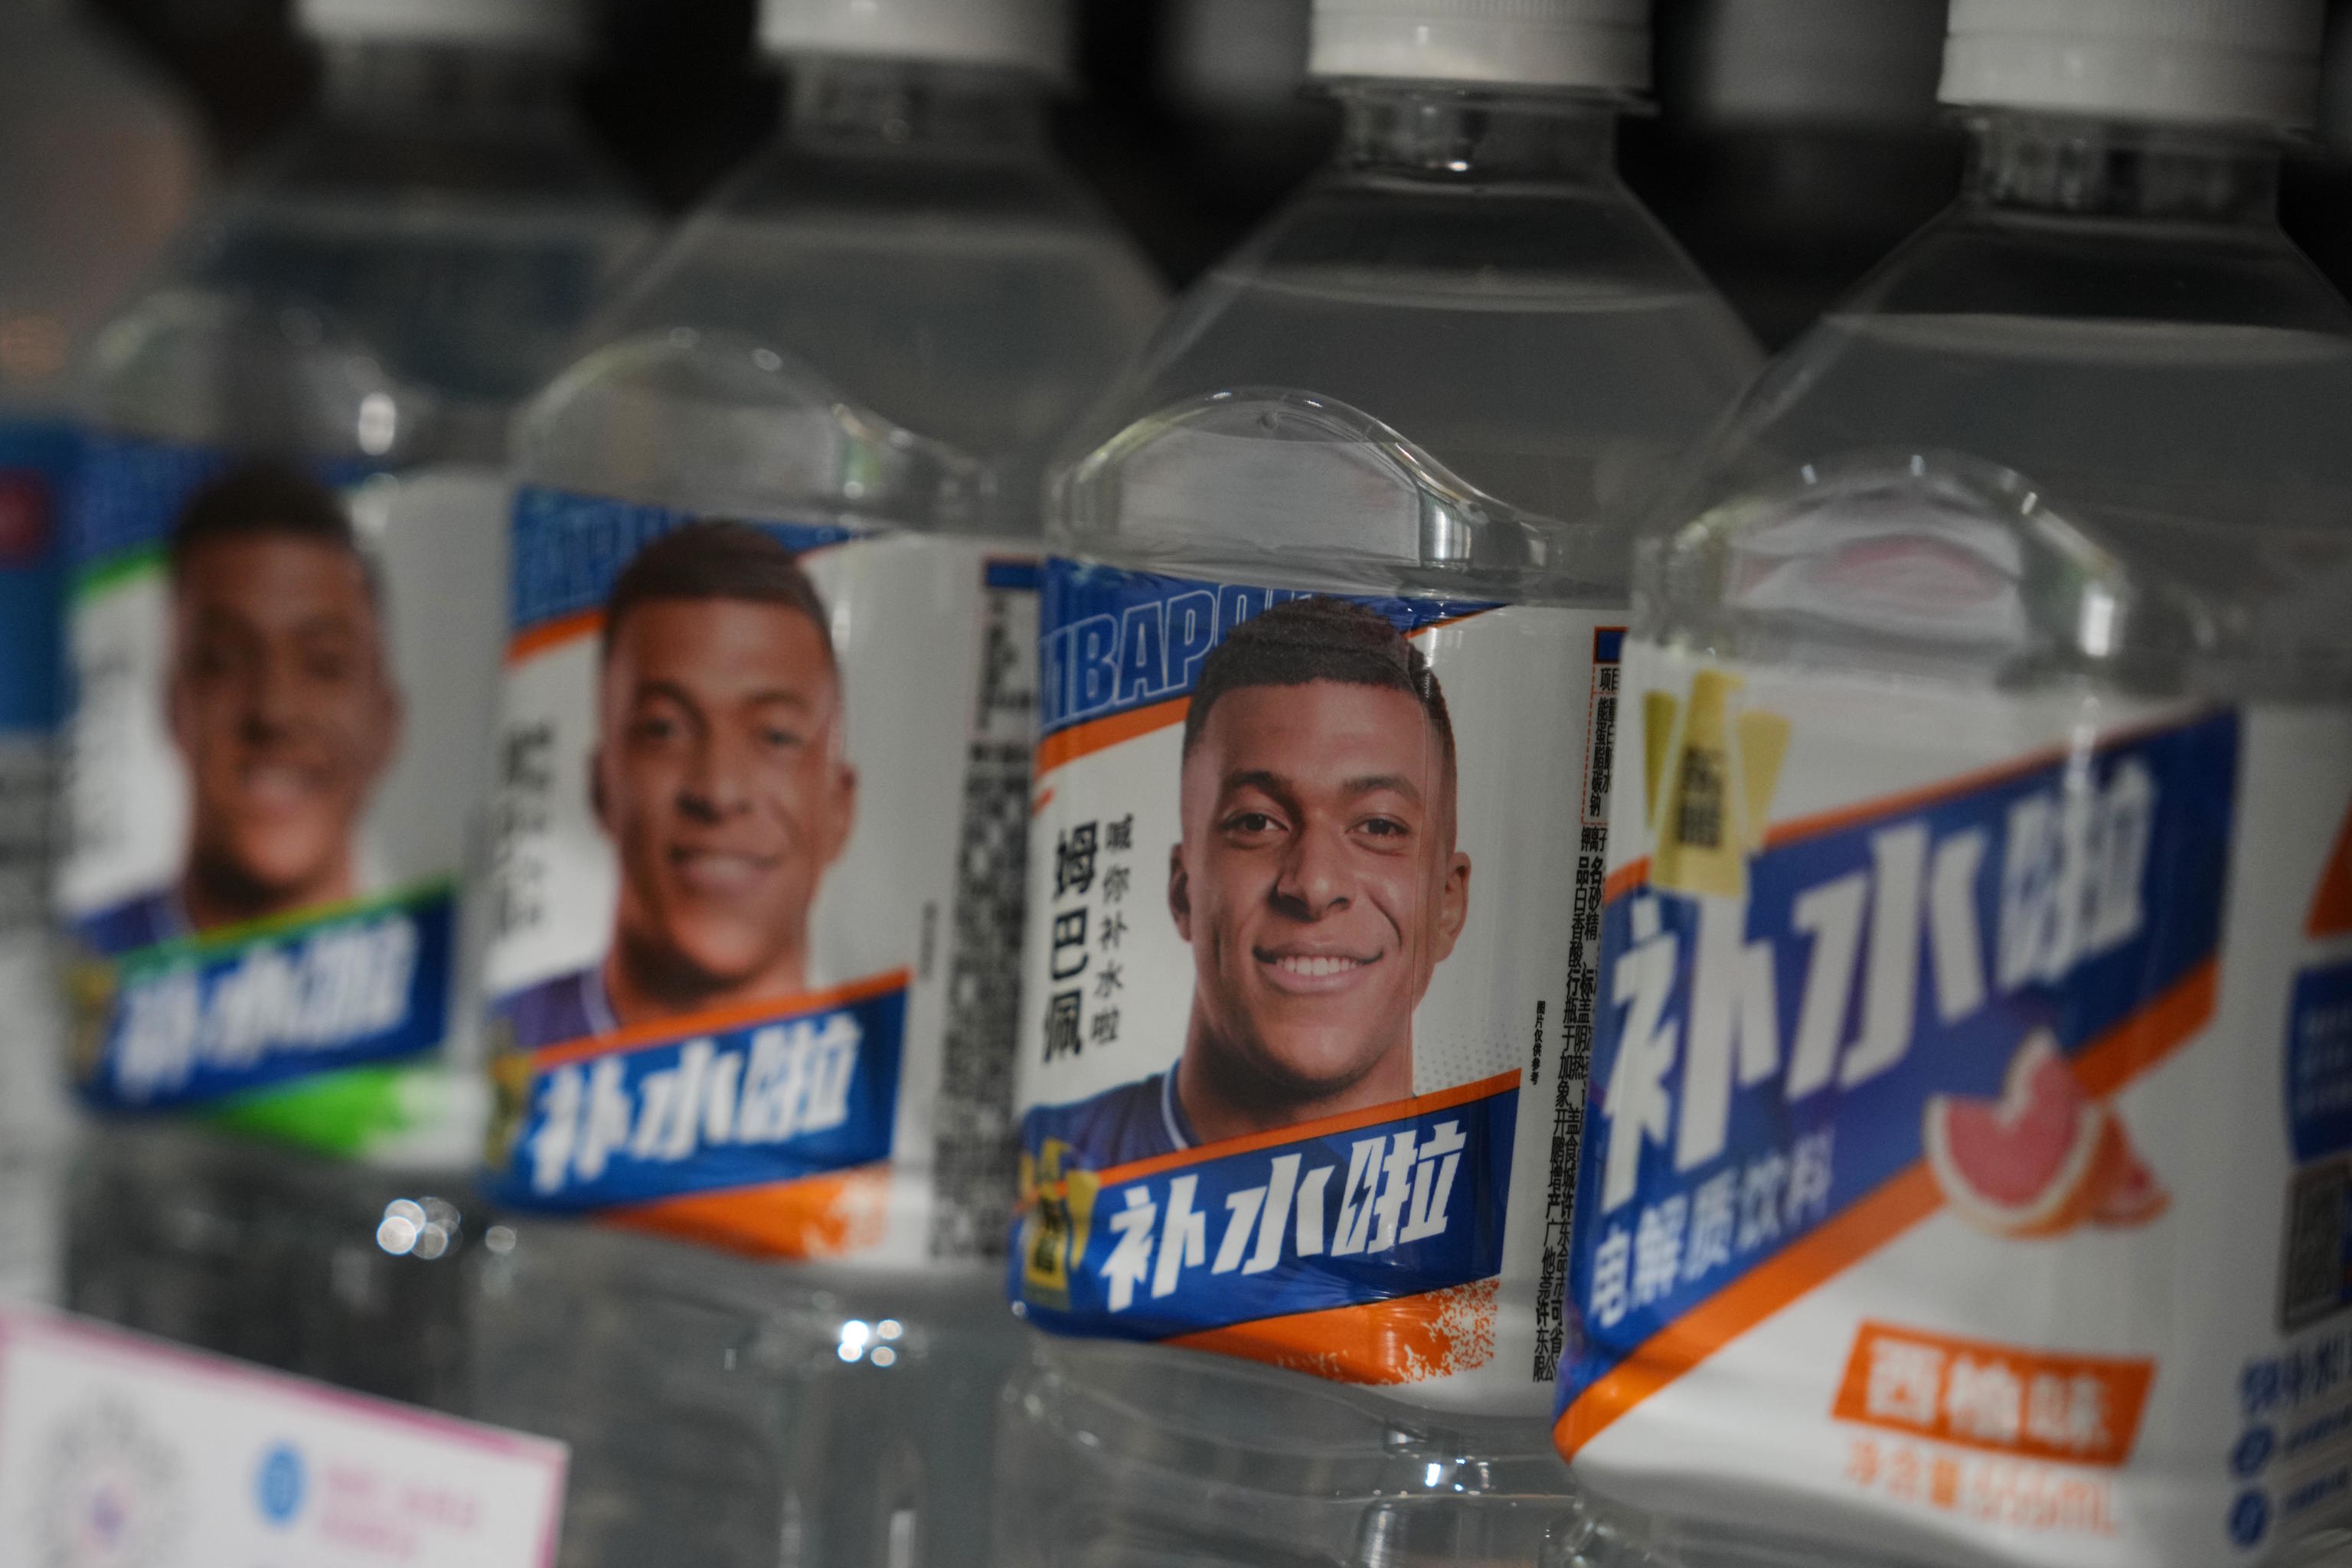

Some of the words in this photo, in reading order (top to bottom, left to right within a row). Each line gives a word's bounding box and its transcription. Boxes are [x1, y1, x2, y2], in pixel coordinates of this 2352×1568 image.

[1042, 820, 1099, 1065] 姆巴佩
[1566, 968, 1597, 999] 行标
[1600, 756, 2154, 1216] 补水啦
[1099, 1119, 1468, 1313] 补水啦
[1553, 1106, 1584, 1136] 开盖
